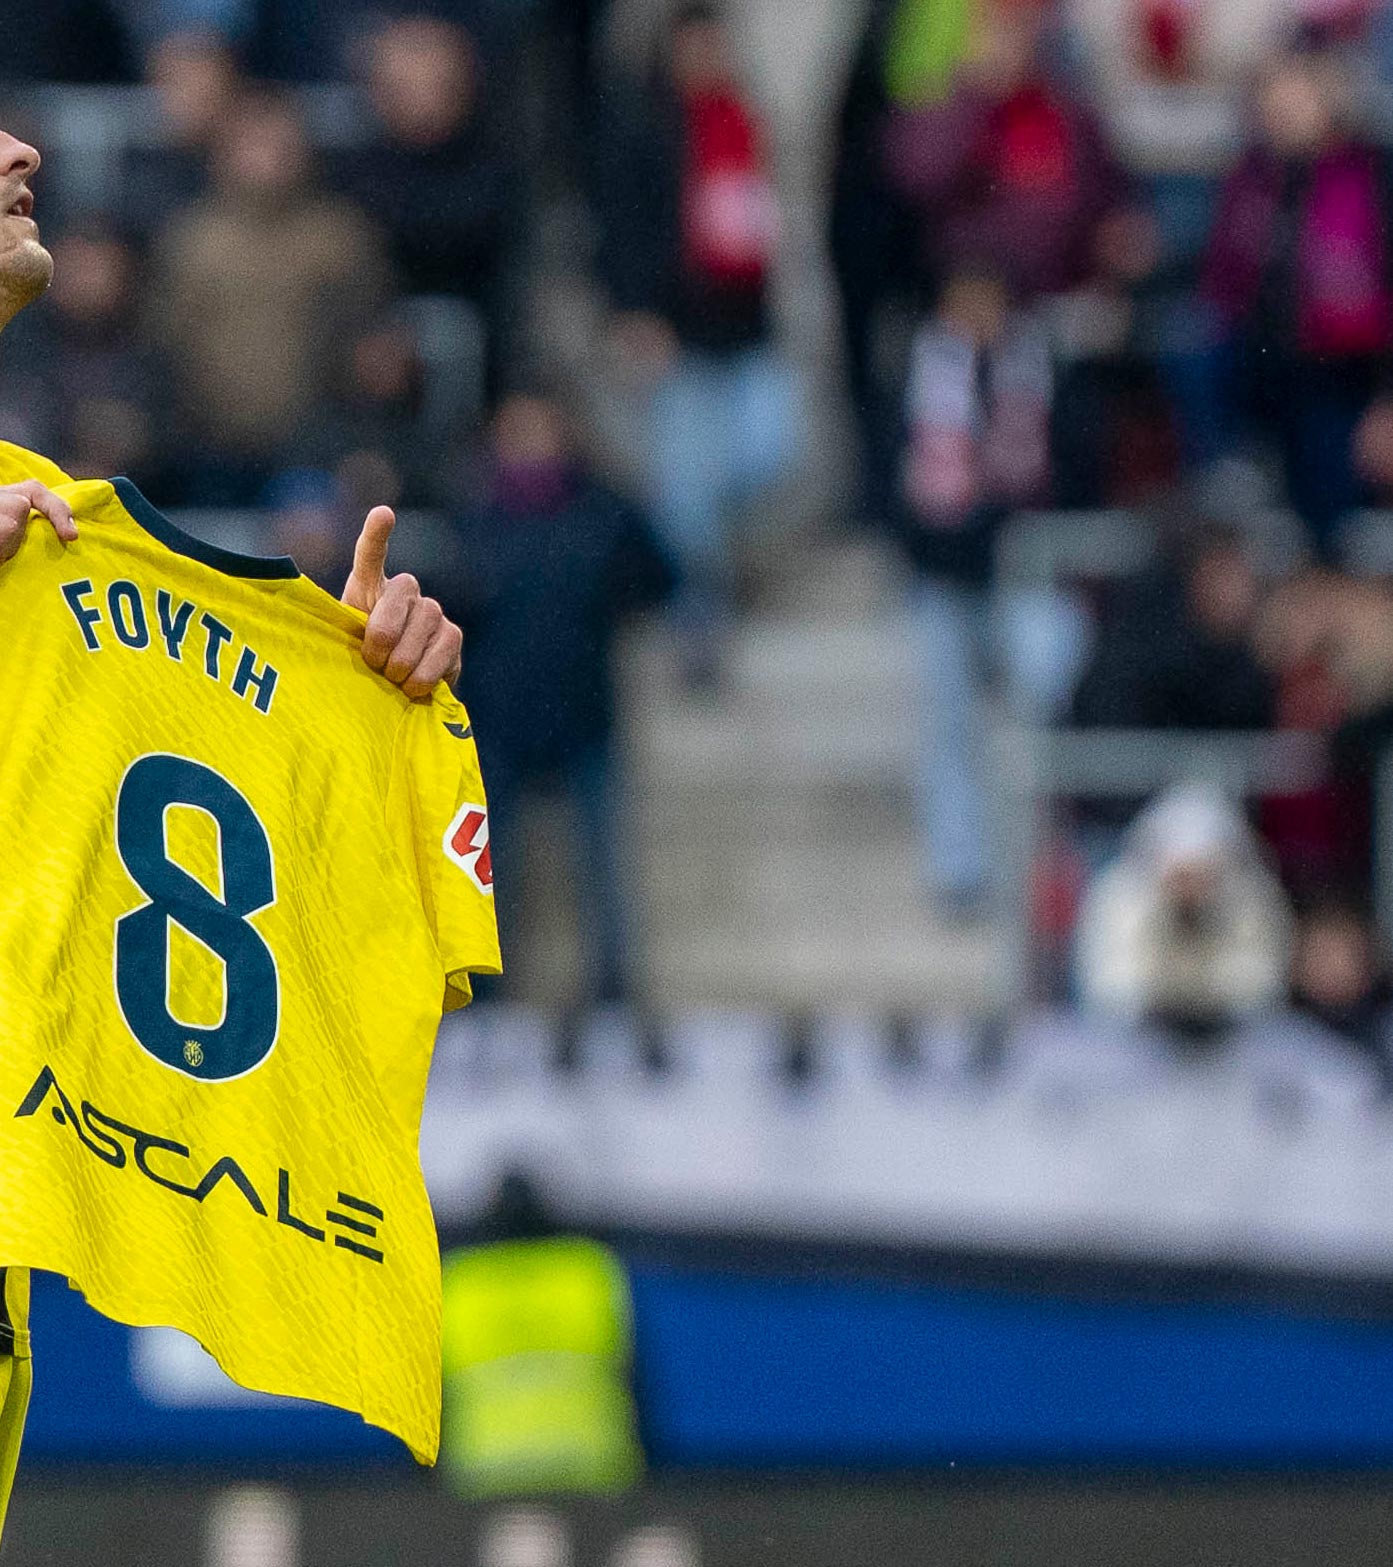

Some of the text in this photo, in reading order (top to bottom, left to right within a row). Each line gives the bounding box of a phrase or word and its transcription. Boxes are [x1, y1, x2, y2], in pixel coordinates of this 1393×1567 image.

[61, 577, 279, 716] FOYTH
[114, 752, 280, 1083] 8
[14, 1065, 384, 1264] ASCALE
